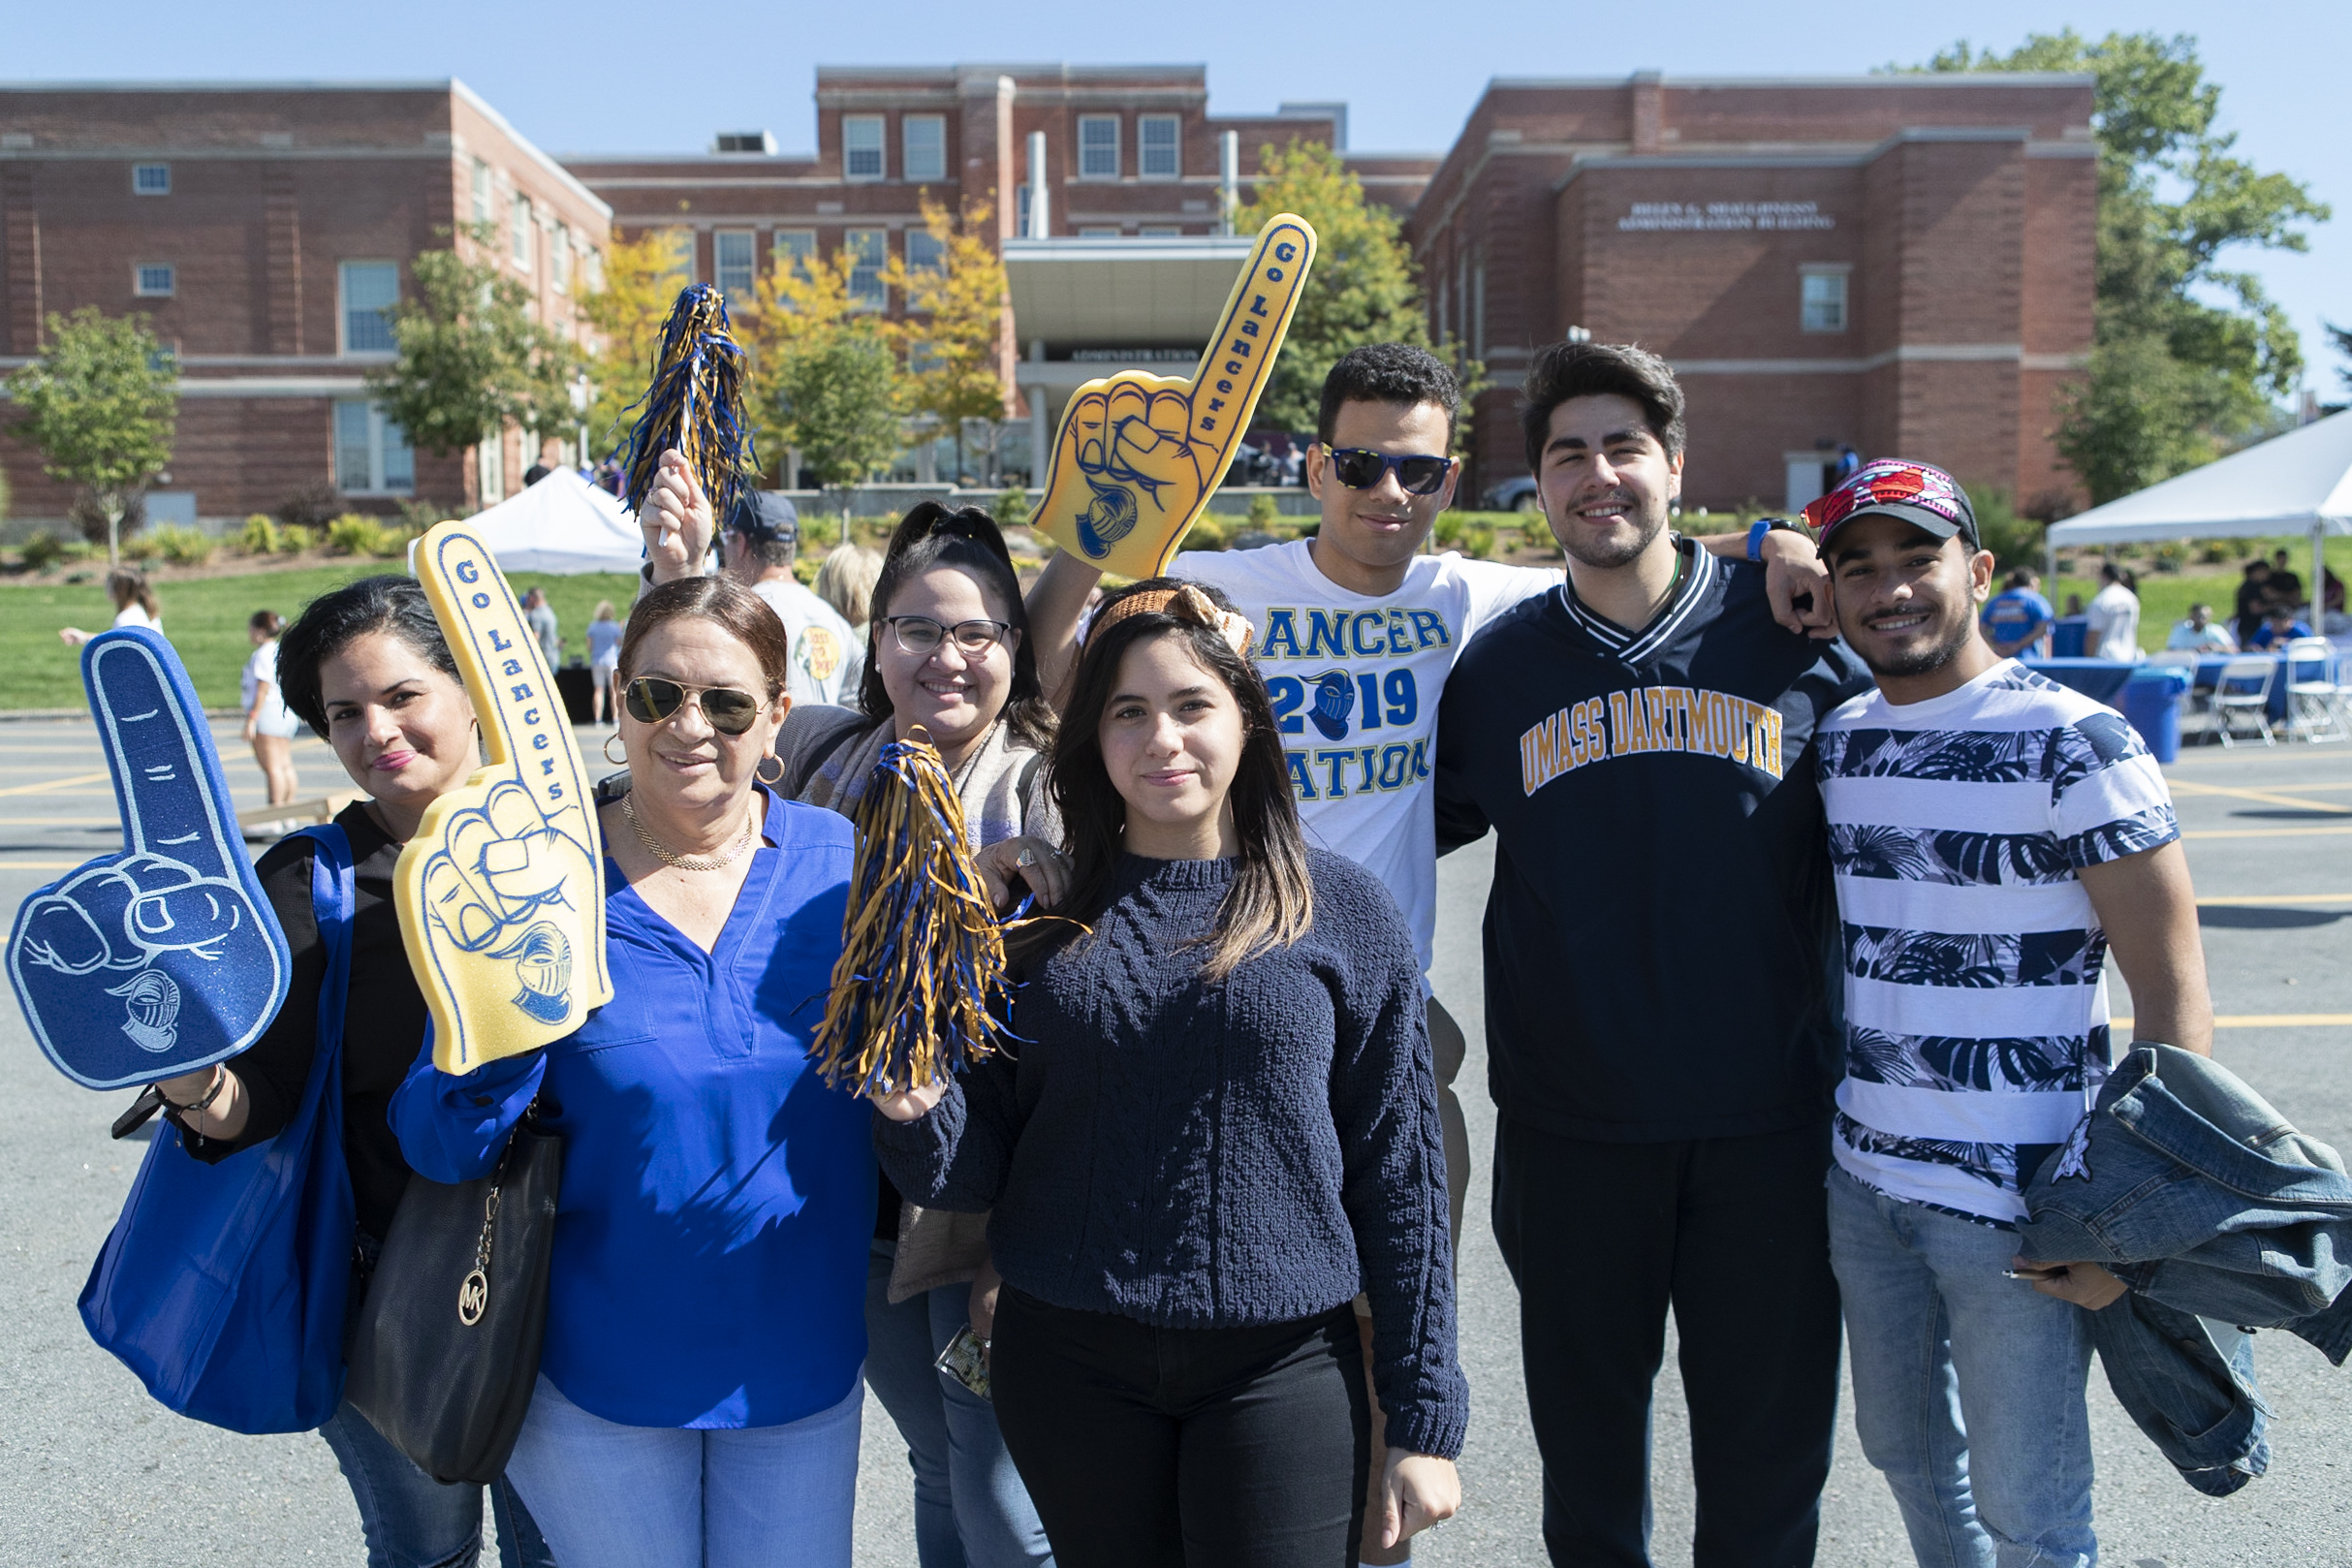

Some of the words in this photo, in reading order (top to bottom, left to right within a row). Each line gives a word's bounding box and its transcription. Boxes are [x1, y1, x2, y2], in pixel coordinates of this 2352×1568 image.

[1266, 242, 1297, 282] Go
[1200, 295, 1267, 431] Lancers
[455, 559, 490, 609] Go
[1250, 607, 1452, 660] ANCER
[487, 629, 563, 800] Lancers
[1520, 696, 1607, 798] UMASS
[1609, 686, 1783, 780] DARTMOUTH
[1285, 737, 1431, 801] ATION
[460, 1283, 485, 1312] MK
